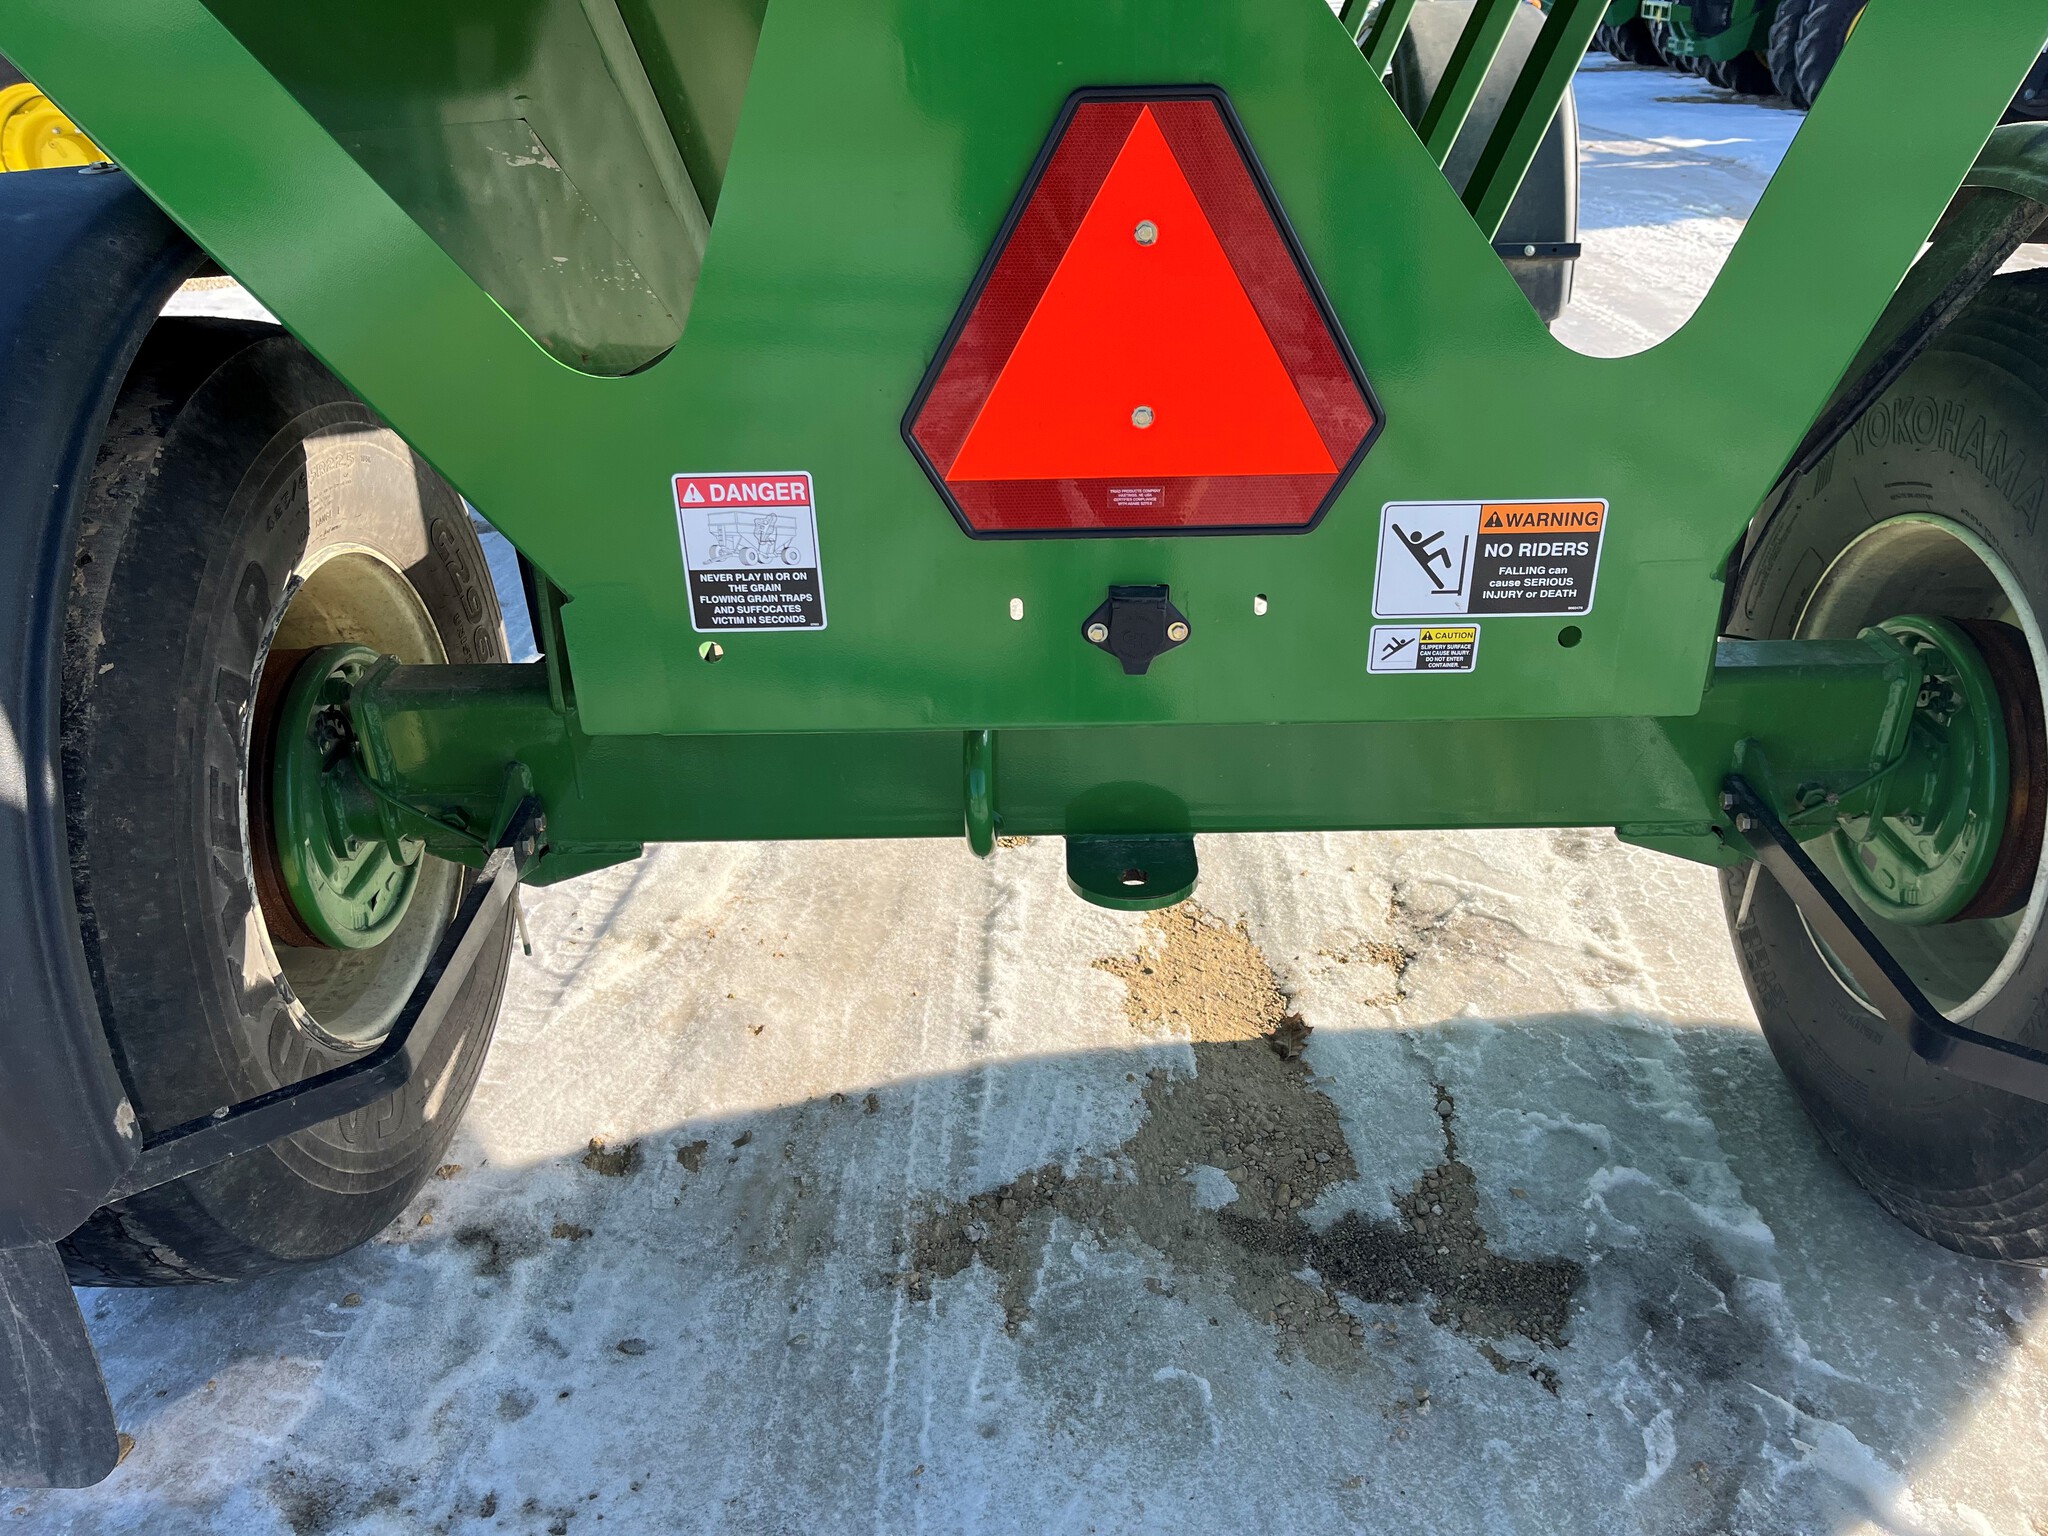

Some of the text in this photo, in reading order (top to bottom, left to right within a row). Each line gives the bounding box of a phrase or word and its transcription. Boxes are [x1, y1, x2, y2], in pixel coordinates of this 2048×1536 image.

[1851, 396, 2045, 537] YOKOHAMA
[709, 482, 806, 502] DANGER
[1506, 511, 1599, 528] WARNING
[1484, 542, 1589, 557] NO RIDERS
[1499, 566, 1568, 575] FALLING can
[700, 572, 807, 582] NEVER PLAY IN OR ON
[728, 583, 782, 592] THE GRAIN
[1489, 577, 1574, 588] cause SERIOUS
[700, 594, 813, 604] FLOWING GRAIN TRAPS
[1482, 590, 1523, 599] INJURY
[1539, 589, 1577, 598] DEATH
[714, 605, 802, 614] AND SUFFOCATES
[712, 615, 806, 624] VICTIM IN SECONDS
